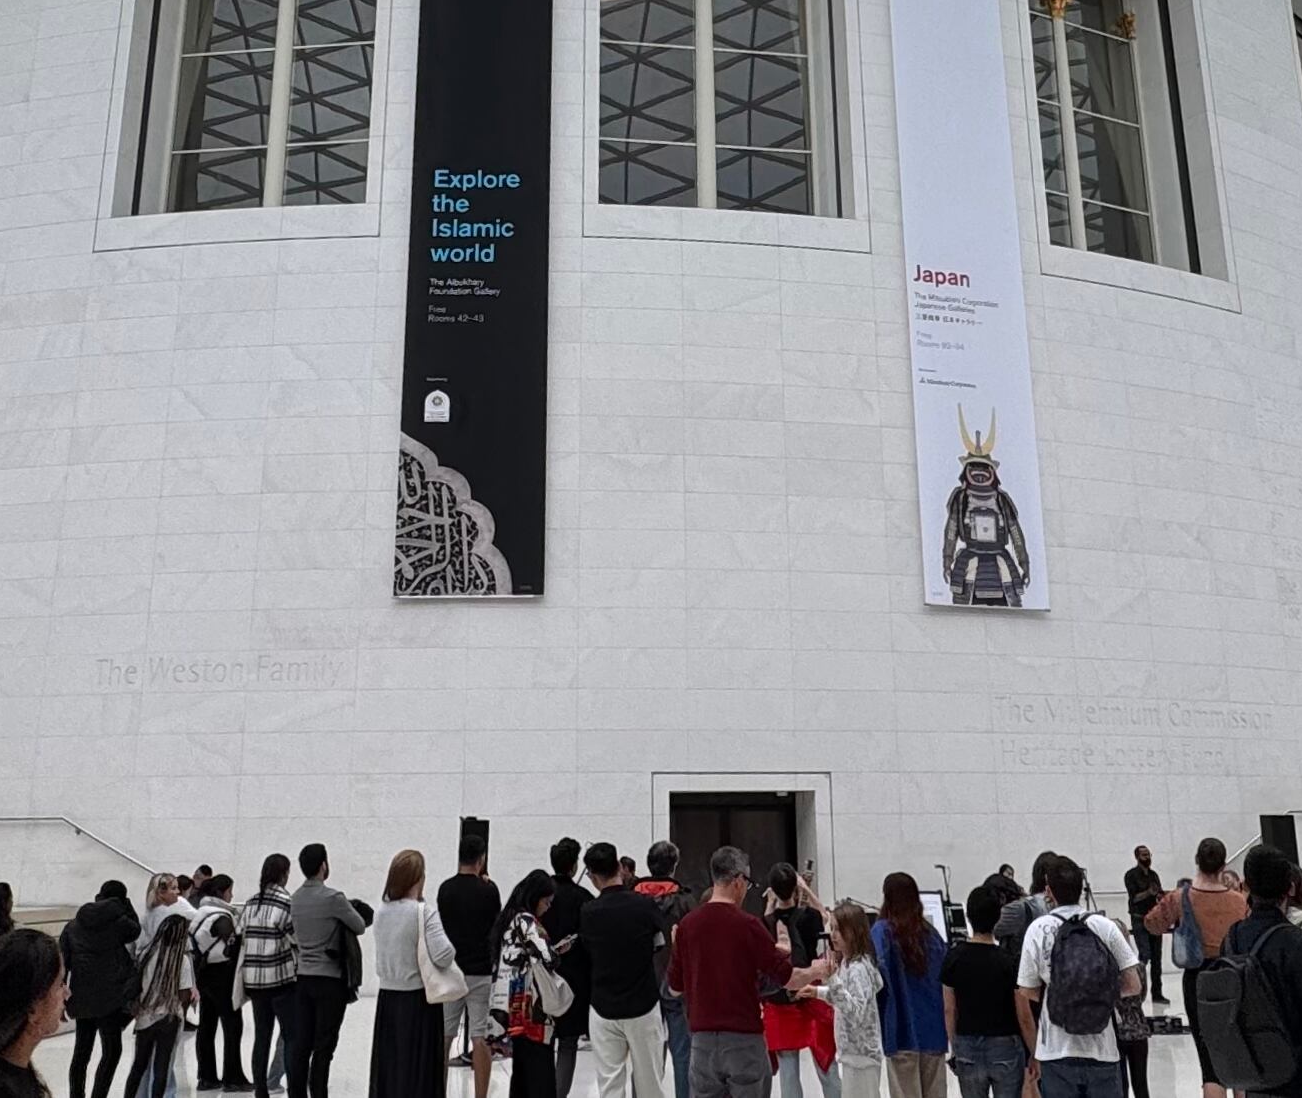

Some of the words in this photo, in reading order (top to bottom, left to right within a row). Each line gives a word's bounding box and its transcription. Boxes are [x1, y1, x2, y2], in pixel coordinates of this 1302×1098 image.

[433, 169, 521, 192] Explore
[431, 193, 470, 213] the
[431, 218, 515, 238] Islamic
[430, 243, 496, 263] world
[429, 278, 445, 287] The
[913, 264, 971, 288] Japan
[95, 657, 138, 686] The
[148, 656, 244, 685] Weston
[256, 654, 344, 687] Family
[993, 695, 1036, 724] The
[1167, 701, 1273, 731] Commission
